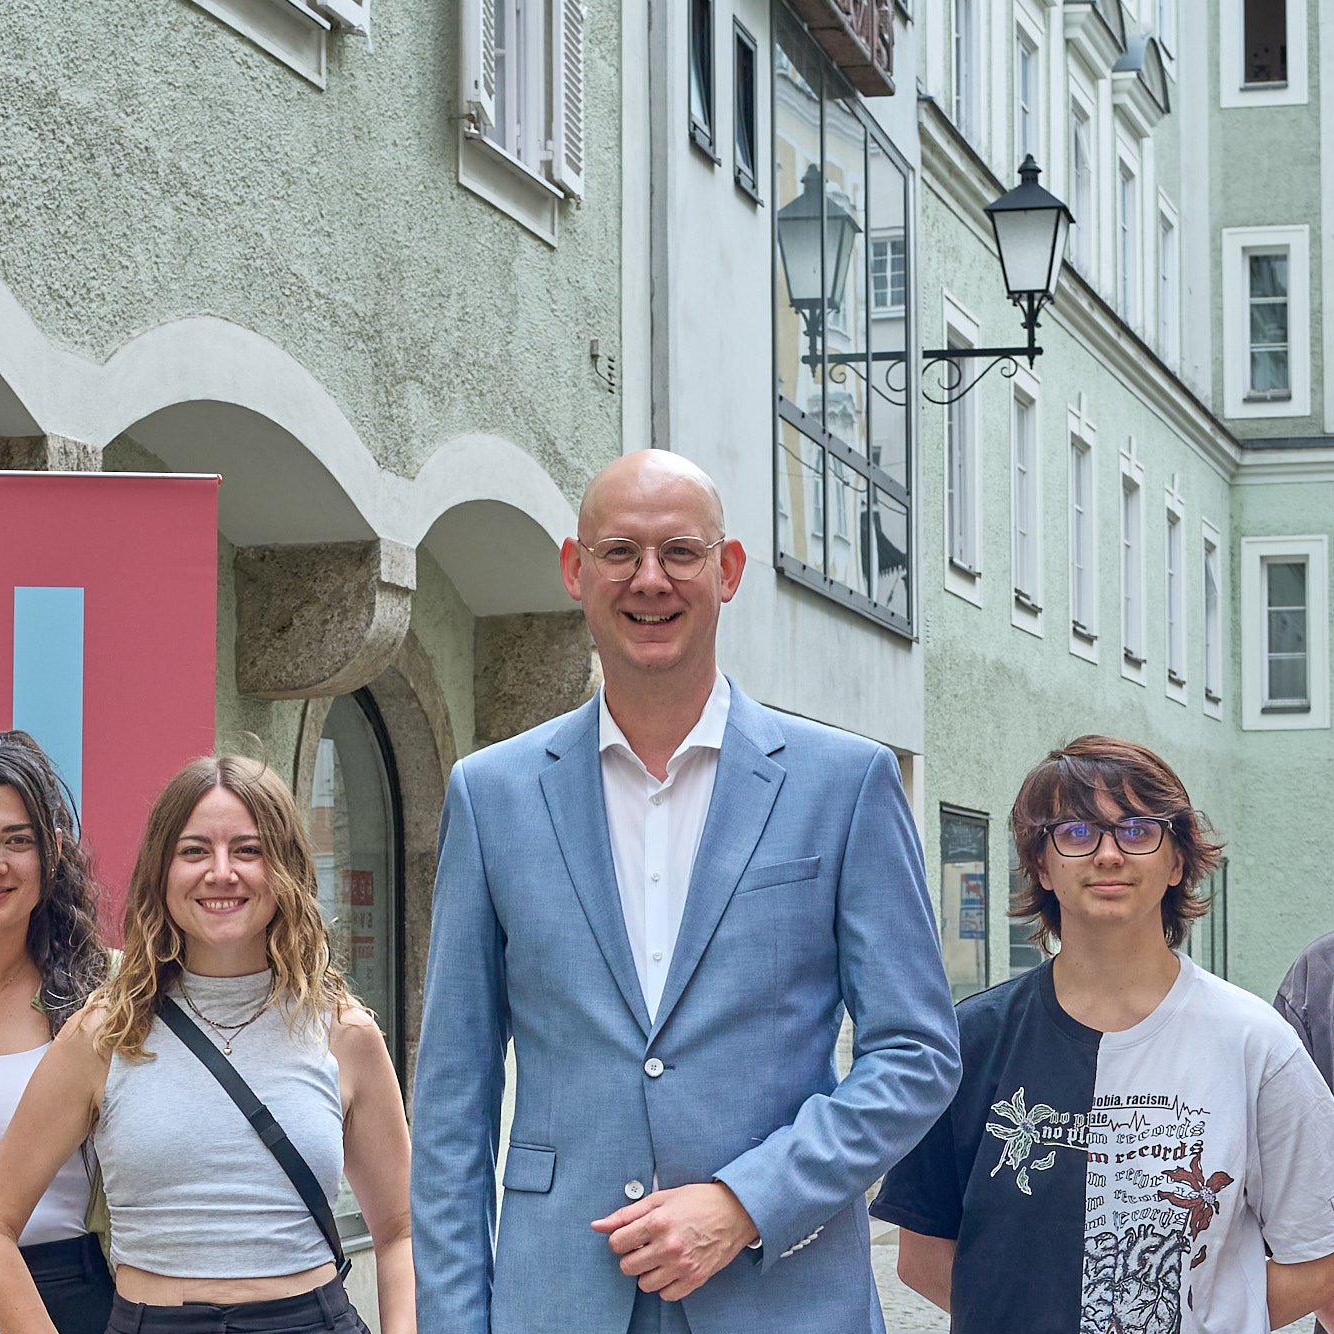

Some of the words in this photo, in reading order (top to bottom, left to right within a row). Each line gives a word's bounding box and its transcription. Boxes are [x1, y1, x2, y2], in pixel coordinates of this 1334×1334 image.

[1126, 1093, 1171, 1107] racism.
[1041, 1125, 1063, 1140] no
[1116, 1117, 1206, 1145] records
[1115, 1139, 1204, 1164] records
[1115, 1168, 1175, 1189] recor
